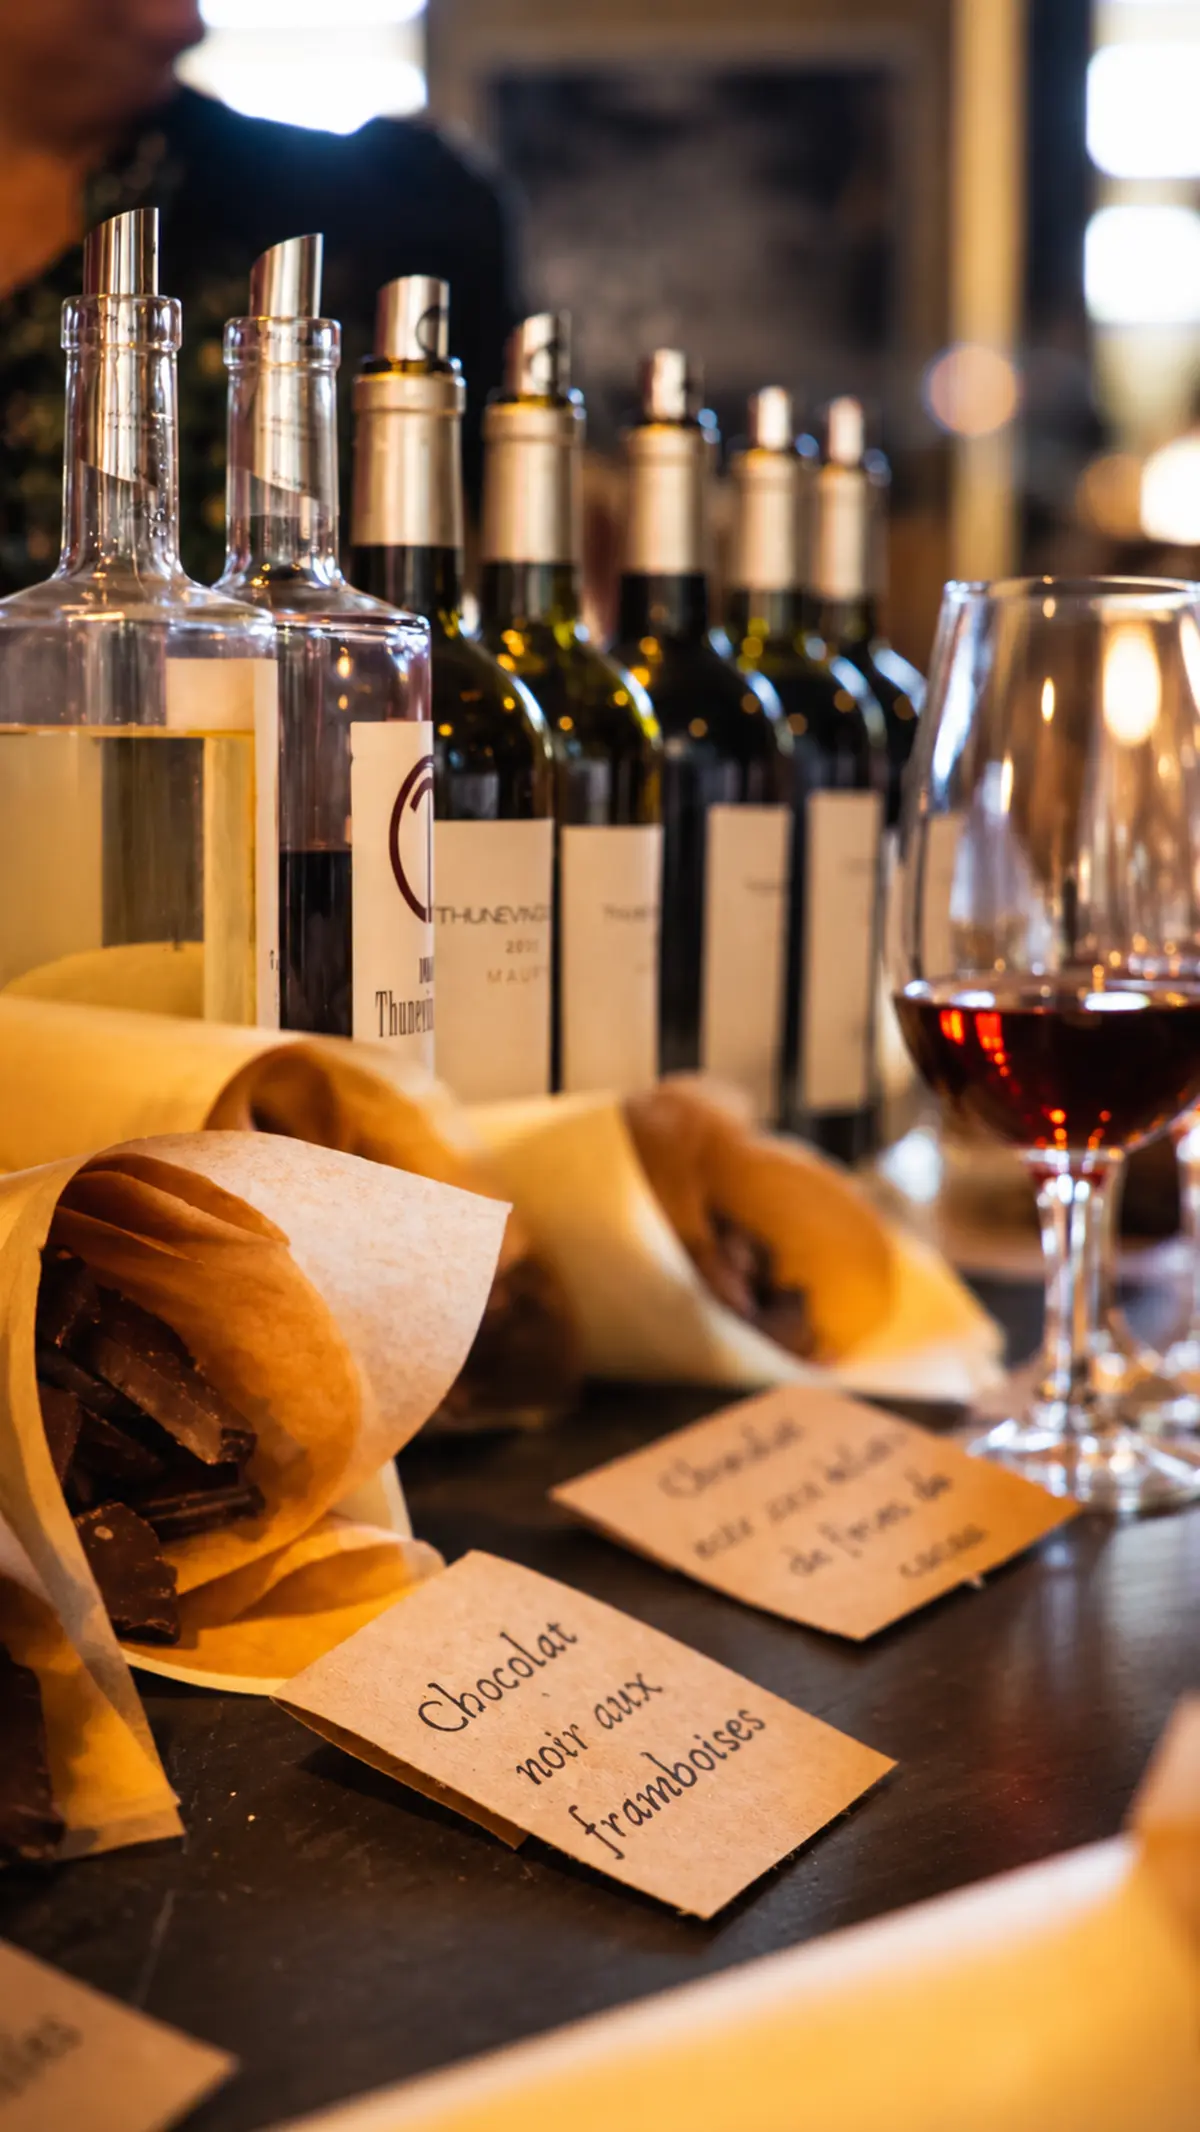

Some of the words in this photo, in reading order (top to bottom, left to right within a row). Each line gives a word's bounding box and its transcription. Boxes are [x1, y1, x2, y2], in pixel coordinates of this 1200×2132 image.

[417, 1621, 578, 1733] Chocolat
[516, 1721, 589, 1786] noir
[593, 1673, 664, 1730] aux
[567, 1707, 767, 1861] framboises
